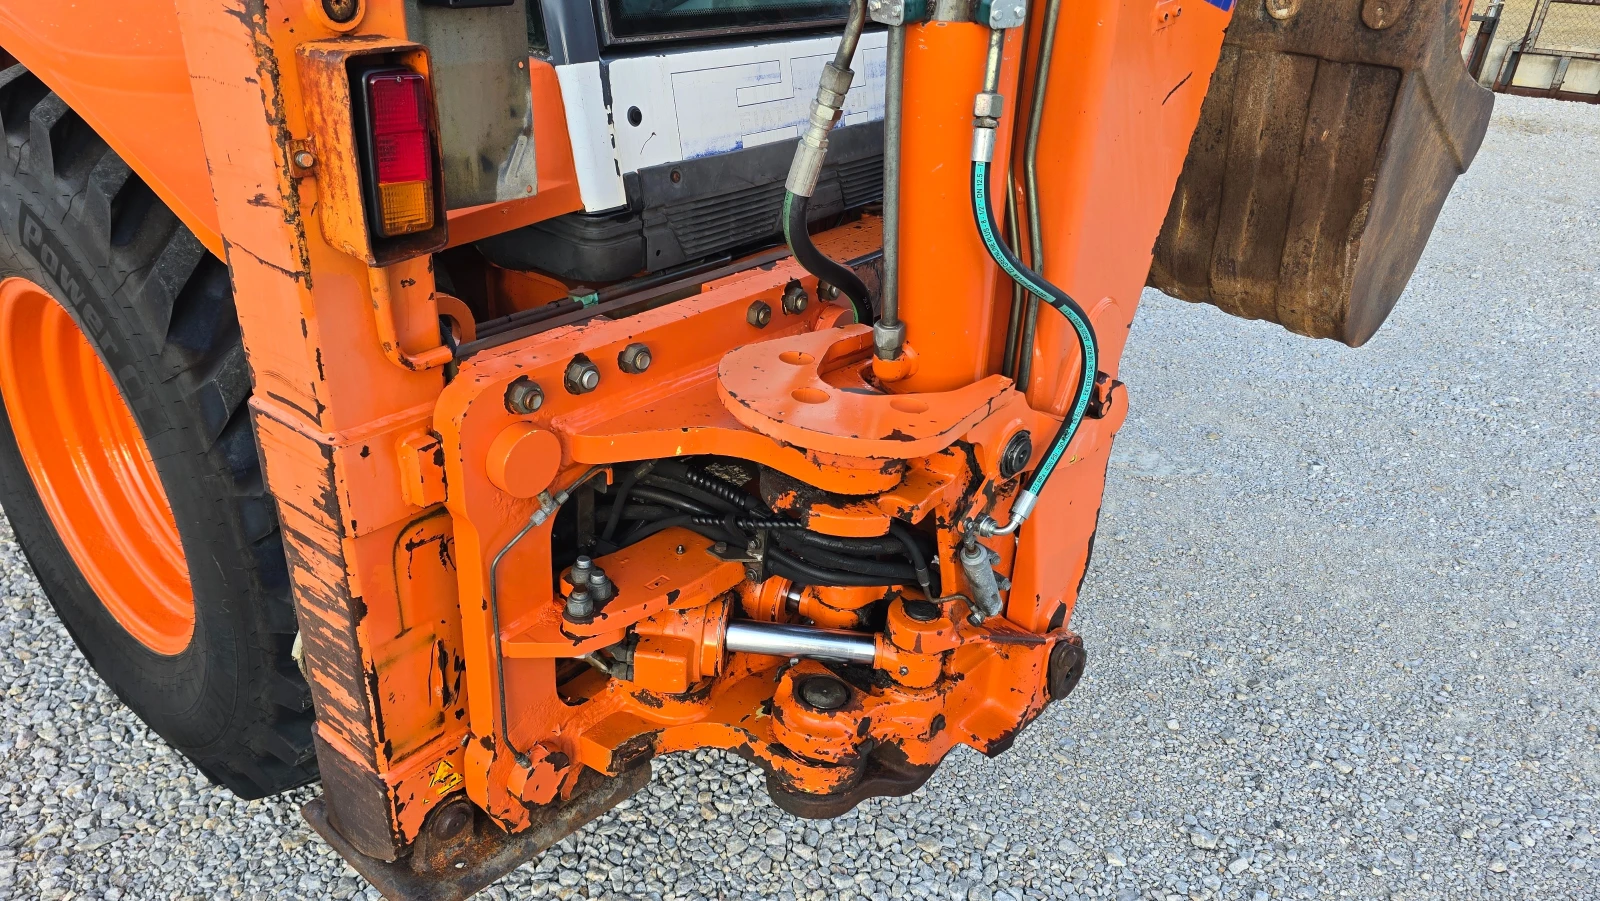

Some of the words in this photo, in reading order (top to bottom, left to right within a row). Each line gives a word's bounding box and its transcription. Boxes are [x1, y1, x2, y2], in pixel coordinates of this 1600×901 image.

[983, 228, 993, 243] PLUS
[23, 214, 119, 353] Power
[1083, 374, 1093, 396] EXCEEDS
